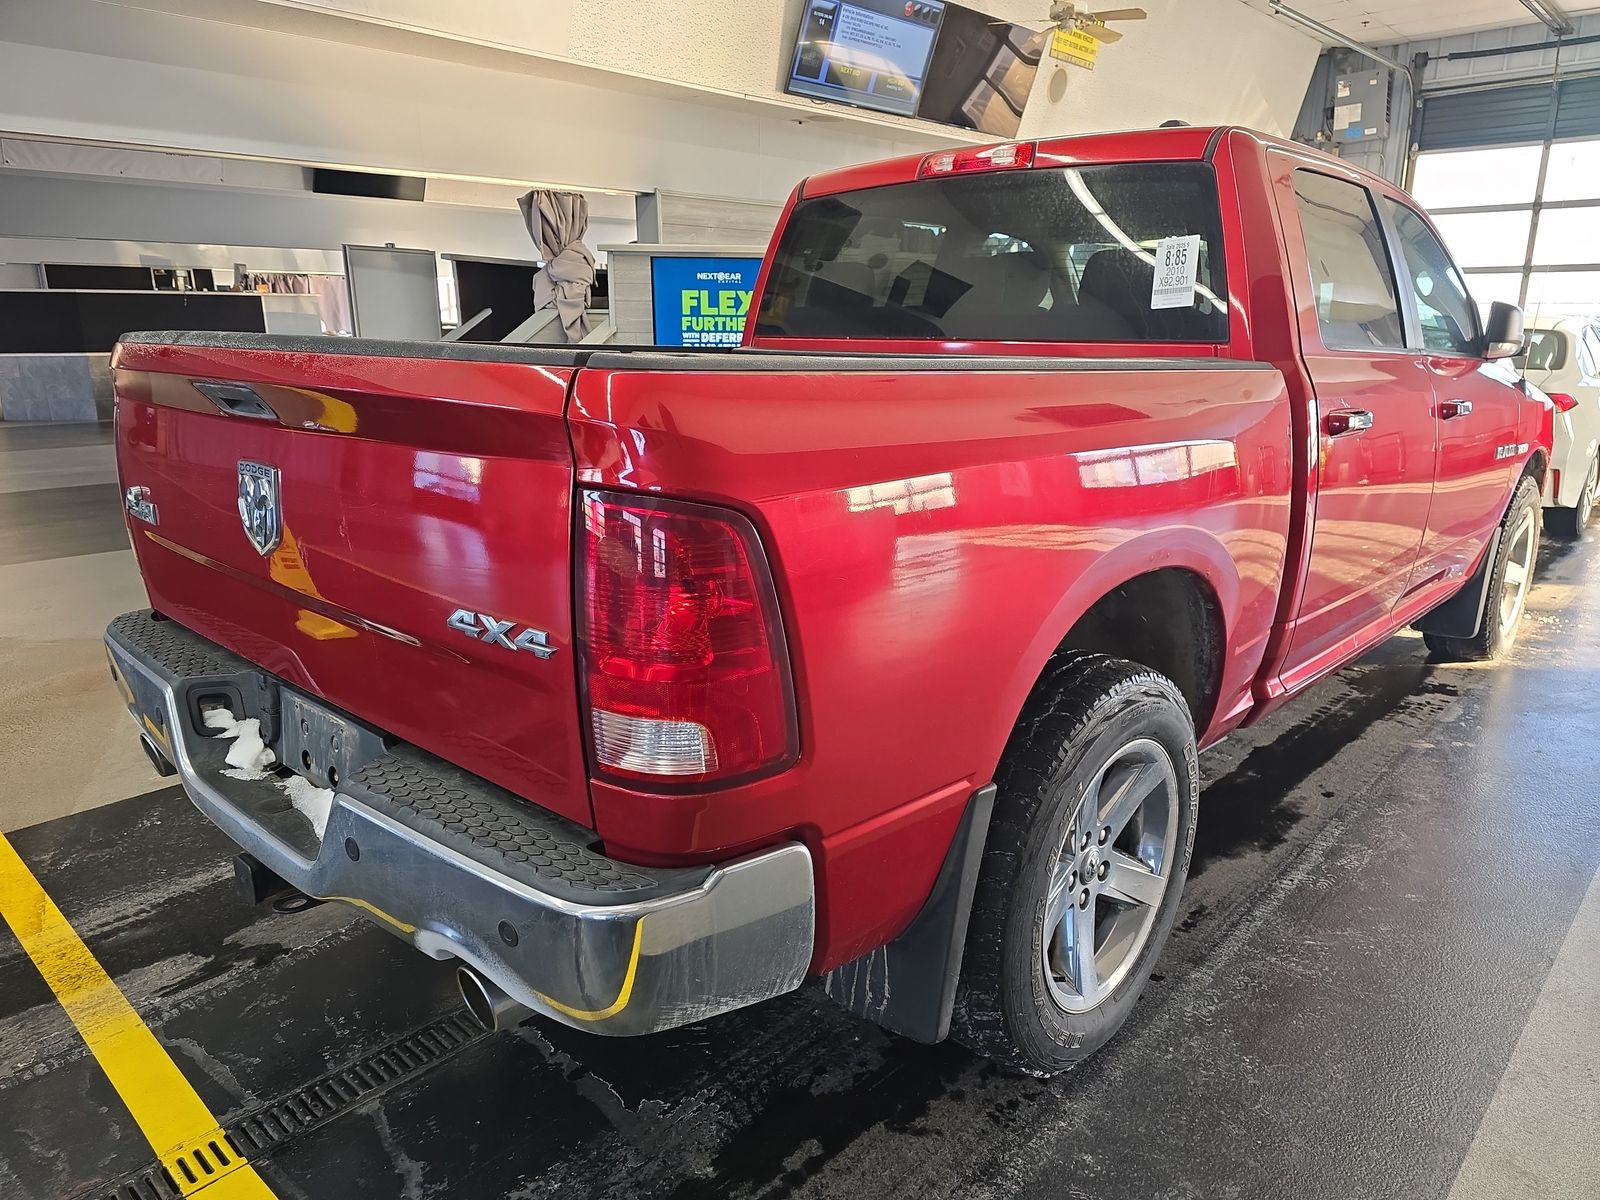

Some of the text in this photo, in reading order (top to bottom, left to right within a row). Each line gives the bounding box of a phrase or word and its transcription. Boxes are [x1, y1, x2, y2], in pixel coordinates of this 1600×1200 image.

[1165, 249, 1187, 267] 8:85
[1166, 266, 1185, 276] 2010
[682, 290, 753, 315] FLEX
[239, 462, 271, 478] DODGE
[1181, 740, 1199, 874] COOPER
[1031, 897, 1085, 1050] DISCOVERER
